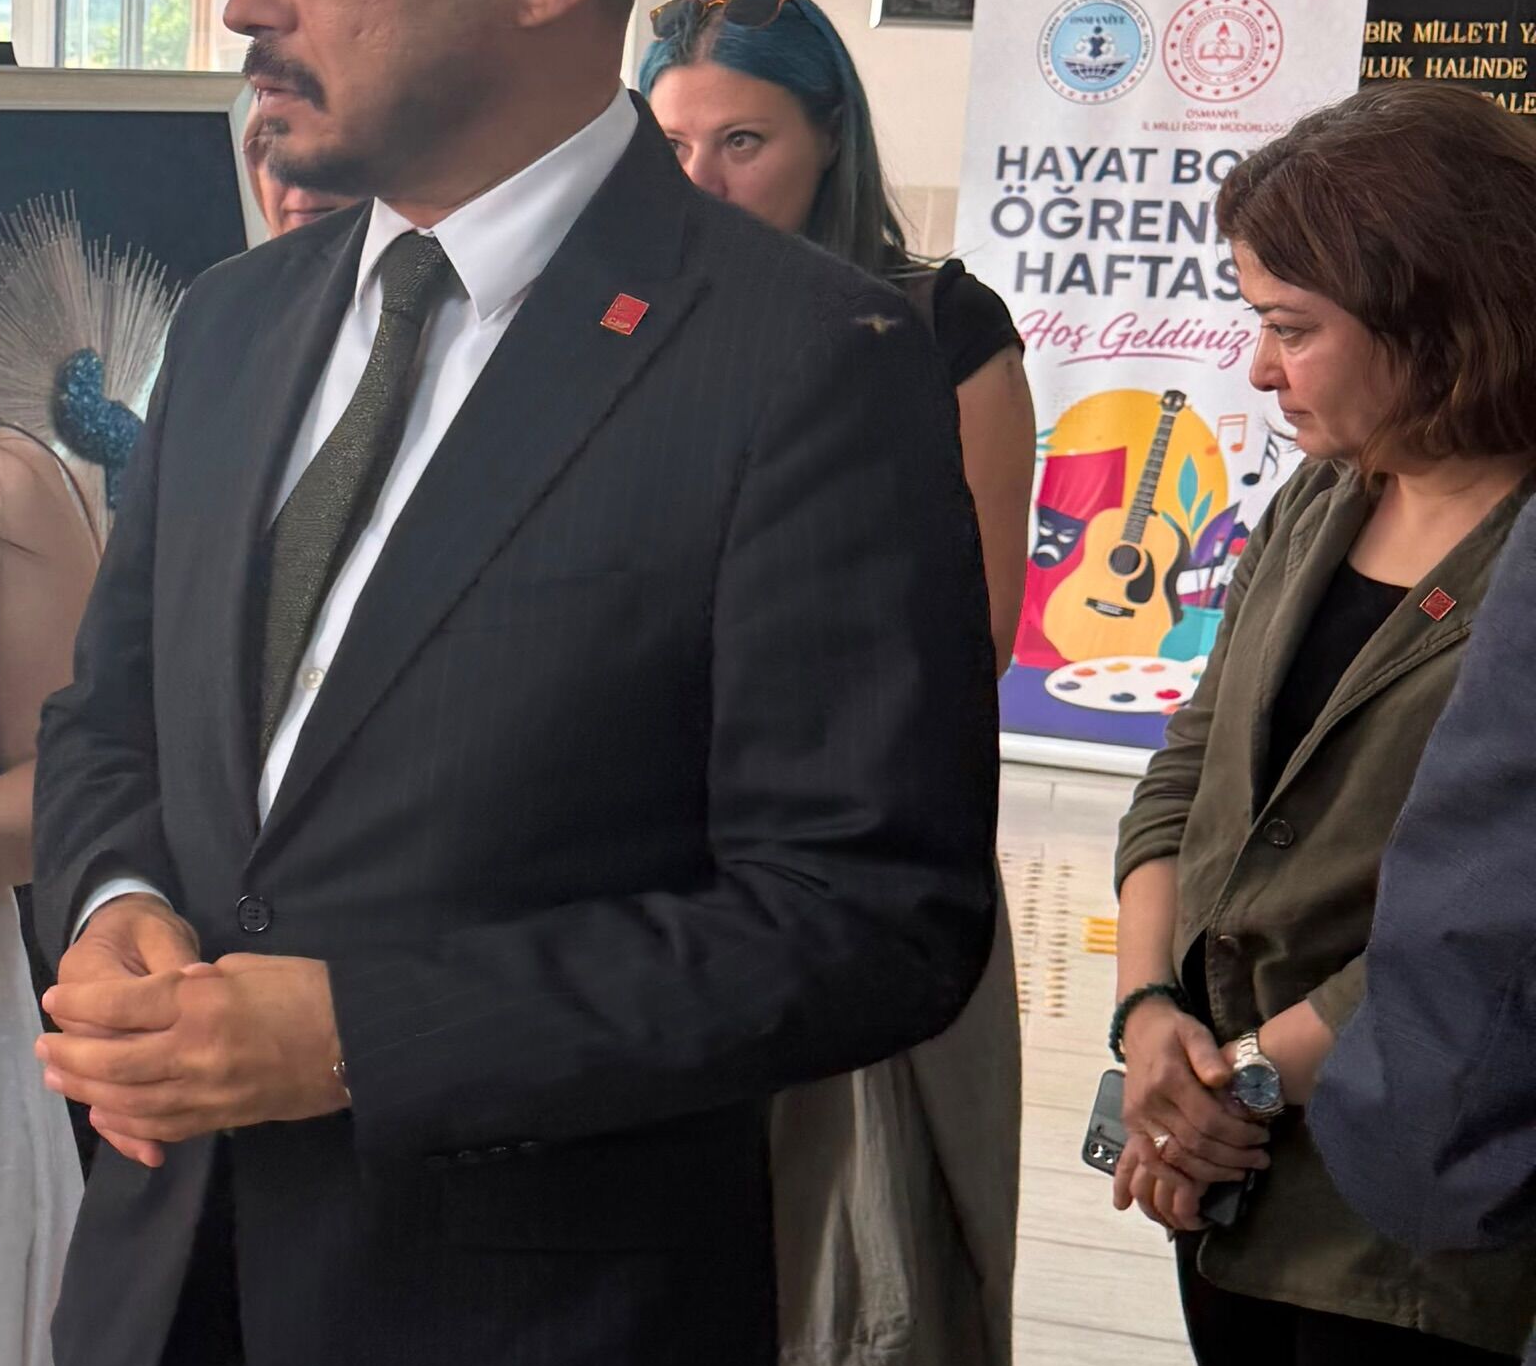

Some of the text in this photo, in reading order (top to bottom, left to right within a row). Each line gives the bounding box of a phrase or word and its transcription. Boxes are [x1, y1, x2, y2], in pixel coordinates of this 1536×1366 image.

[1364, 19, 1403, 43] BİR
[1413, 19, 1508, 43] MİLLETİ
[1424, 55, 1528, 79] HALİNDE
[995, 145, 1259, 185] HAYAT BO
[990, 184, 1226, 245] ÖĞREN
[1018, 308, 1255, 369] Hoş Geldiniz
